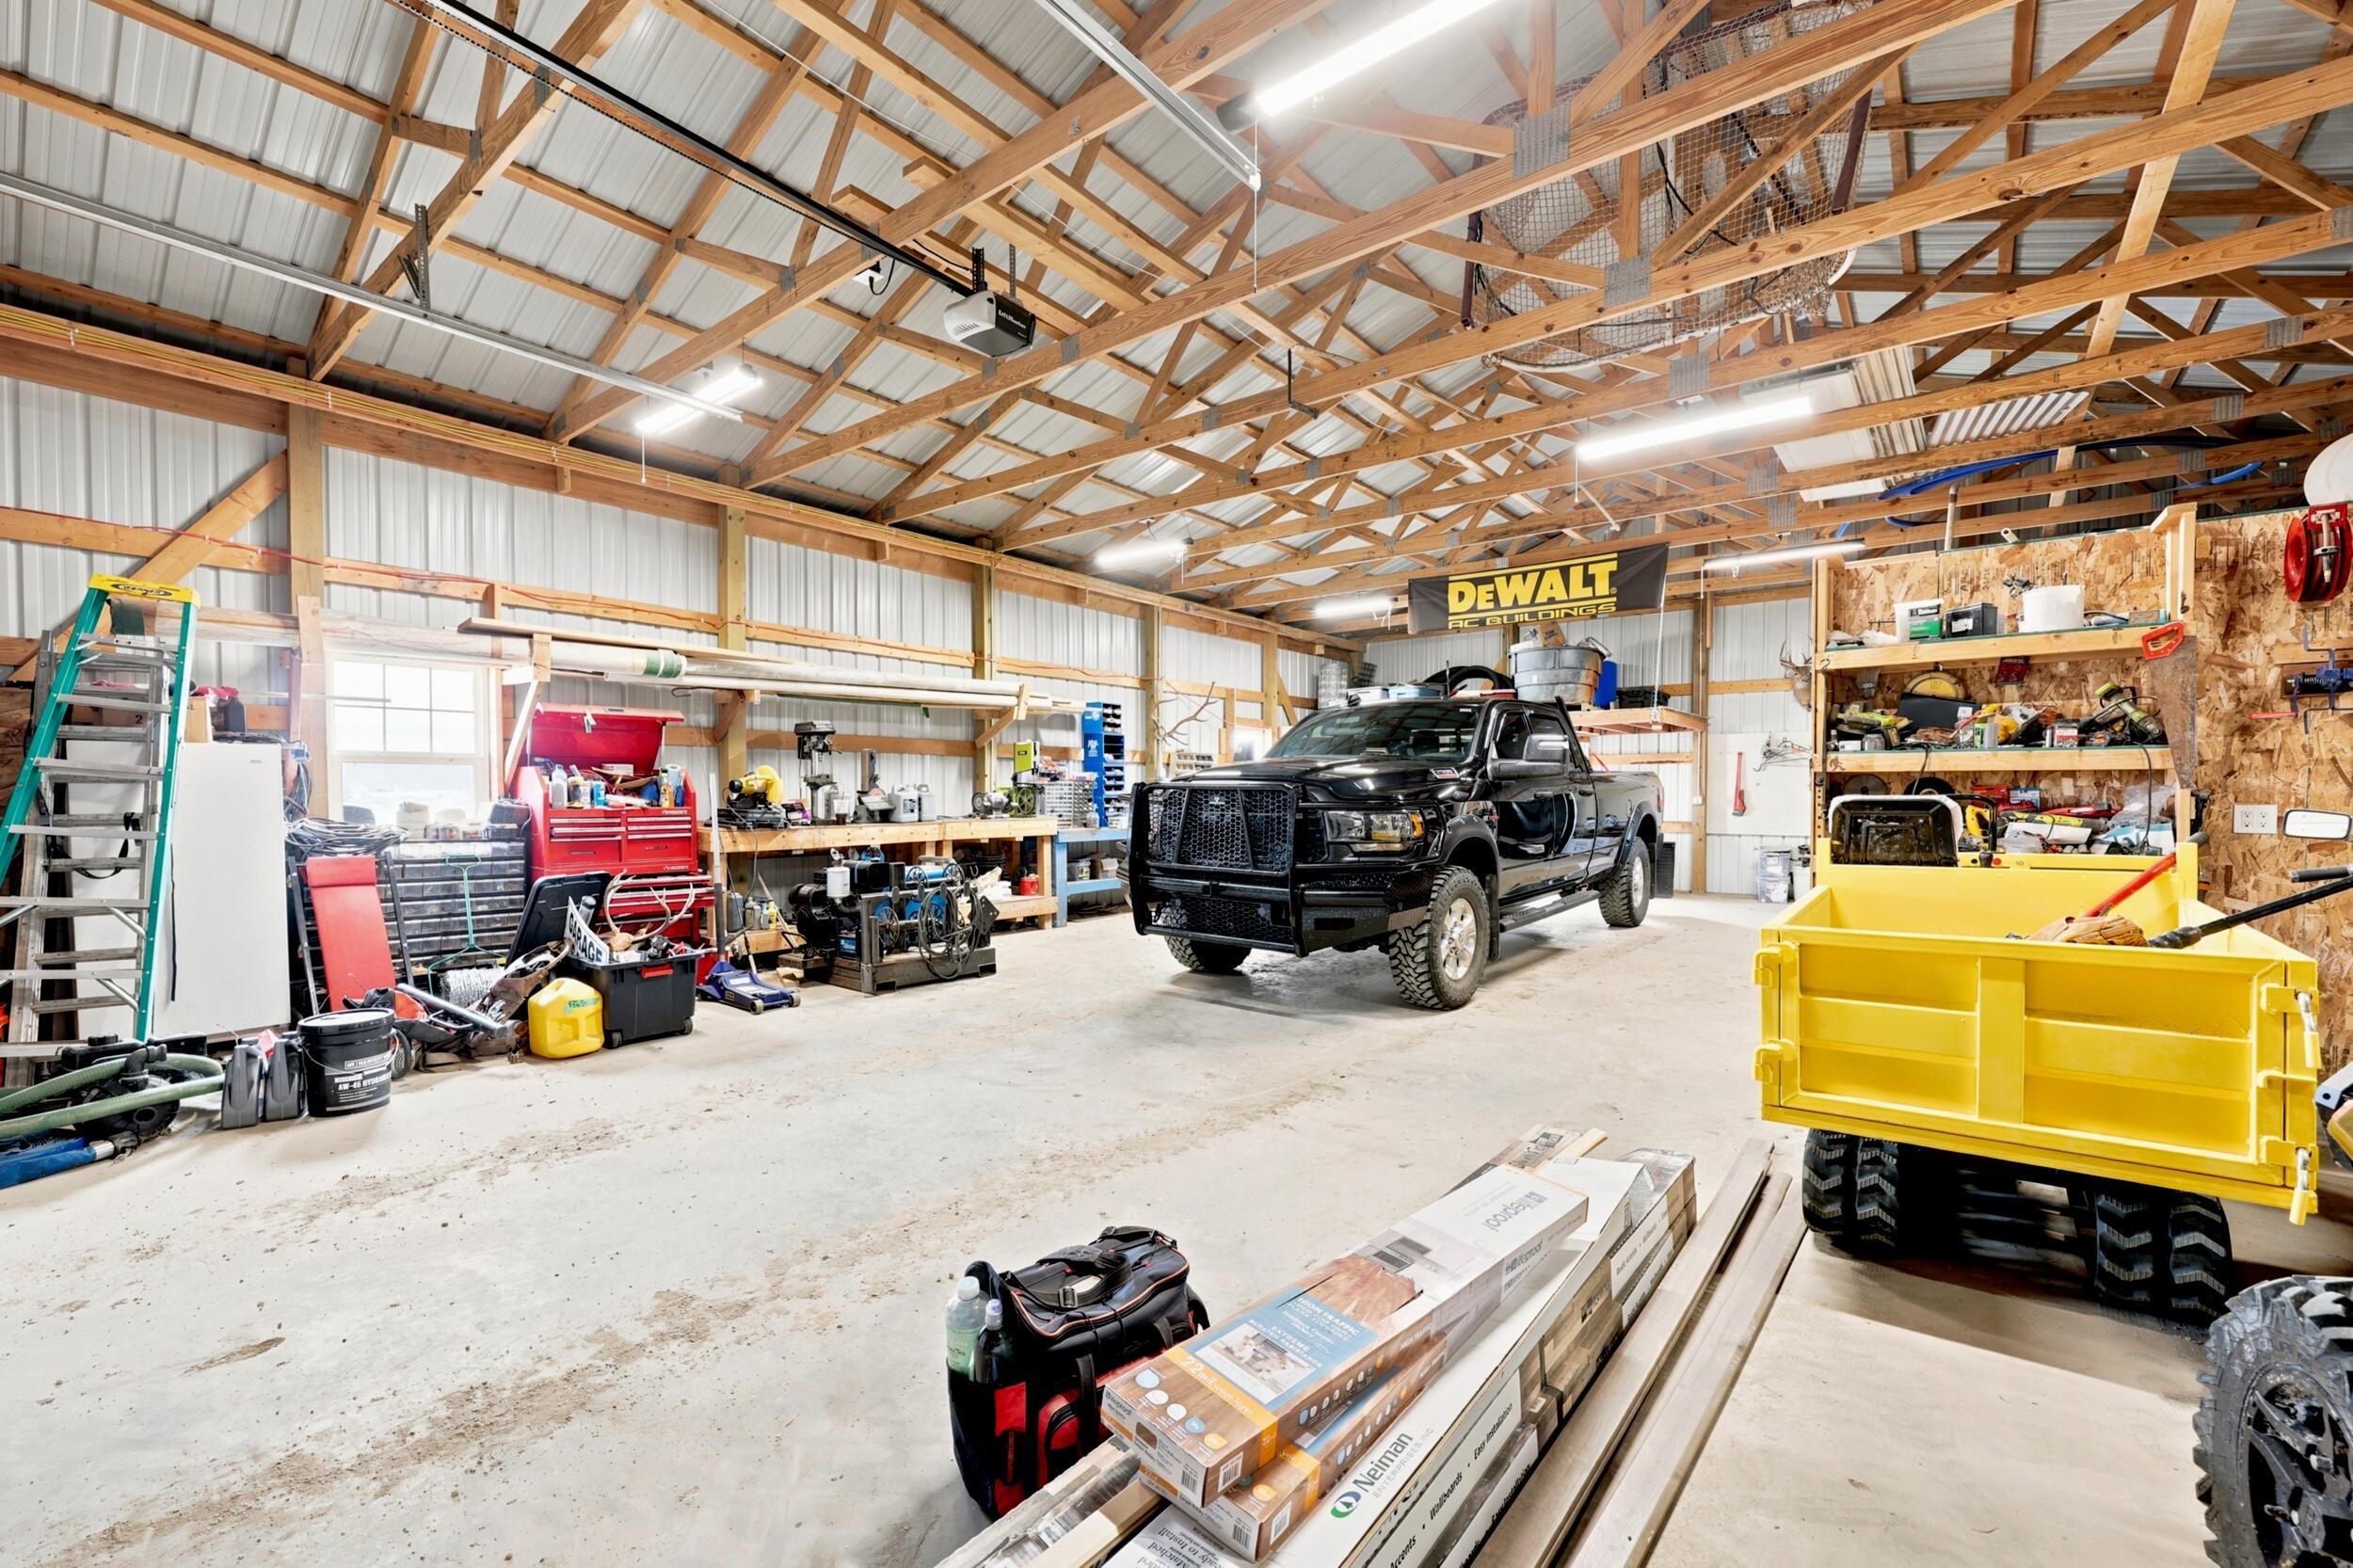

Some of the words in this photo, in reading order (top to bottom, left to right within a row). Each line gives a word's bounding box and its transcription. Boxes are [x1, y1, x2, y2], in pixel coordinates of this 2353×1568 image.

[1485, 602, 1618, 626] BUILDINGS
[135, 714, 143, 725] 2
[568, 912, 602, 962] GARAGE
[1181, 1356, 1205, 1374] 22
[1353, 1432, 1414, 1493] Neiman
[1390, 1535, 1417, 1568] Accents
[1430, 1471, 1464, 1521] Wallboards
[1474, 1443, 1486, 1461] Easy
[1485, 1402, 1513, 1440] Installation
[1158, 1527, 1187, 1549] Install
[1147, 1541, 1189, 1568] Matched
[1187, 1545, 1198, 1556] to
